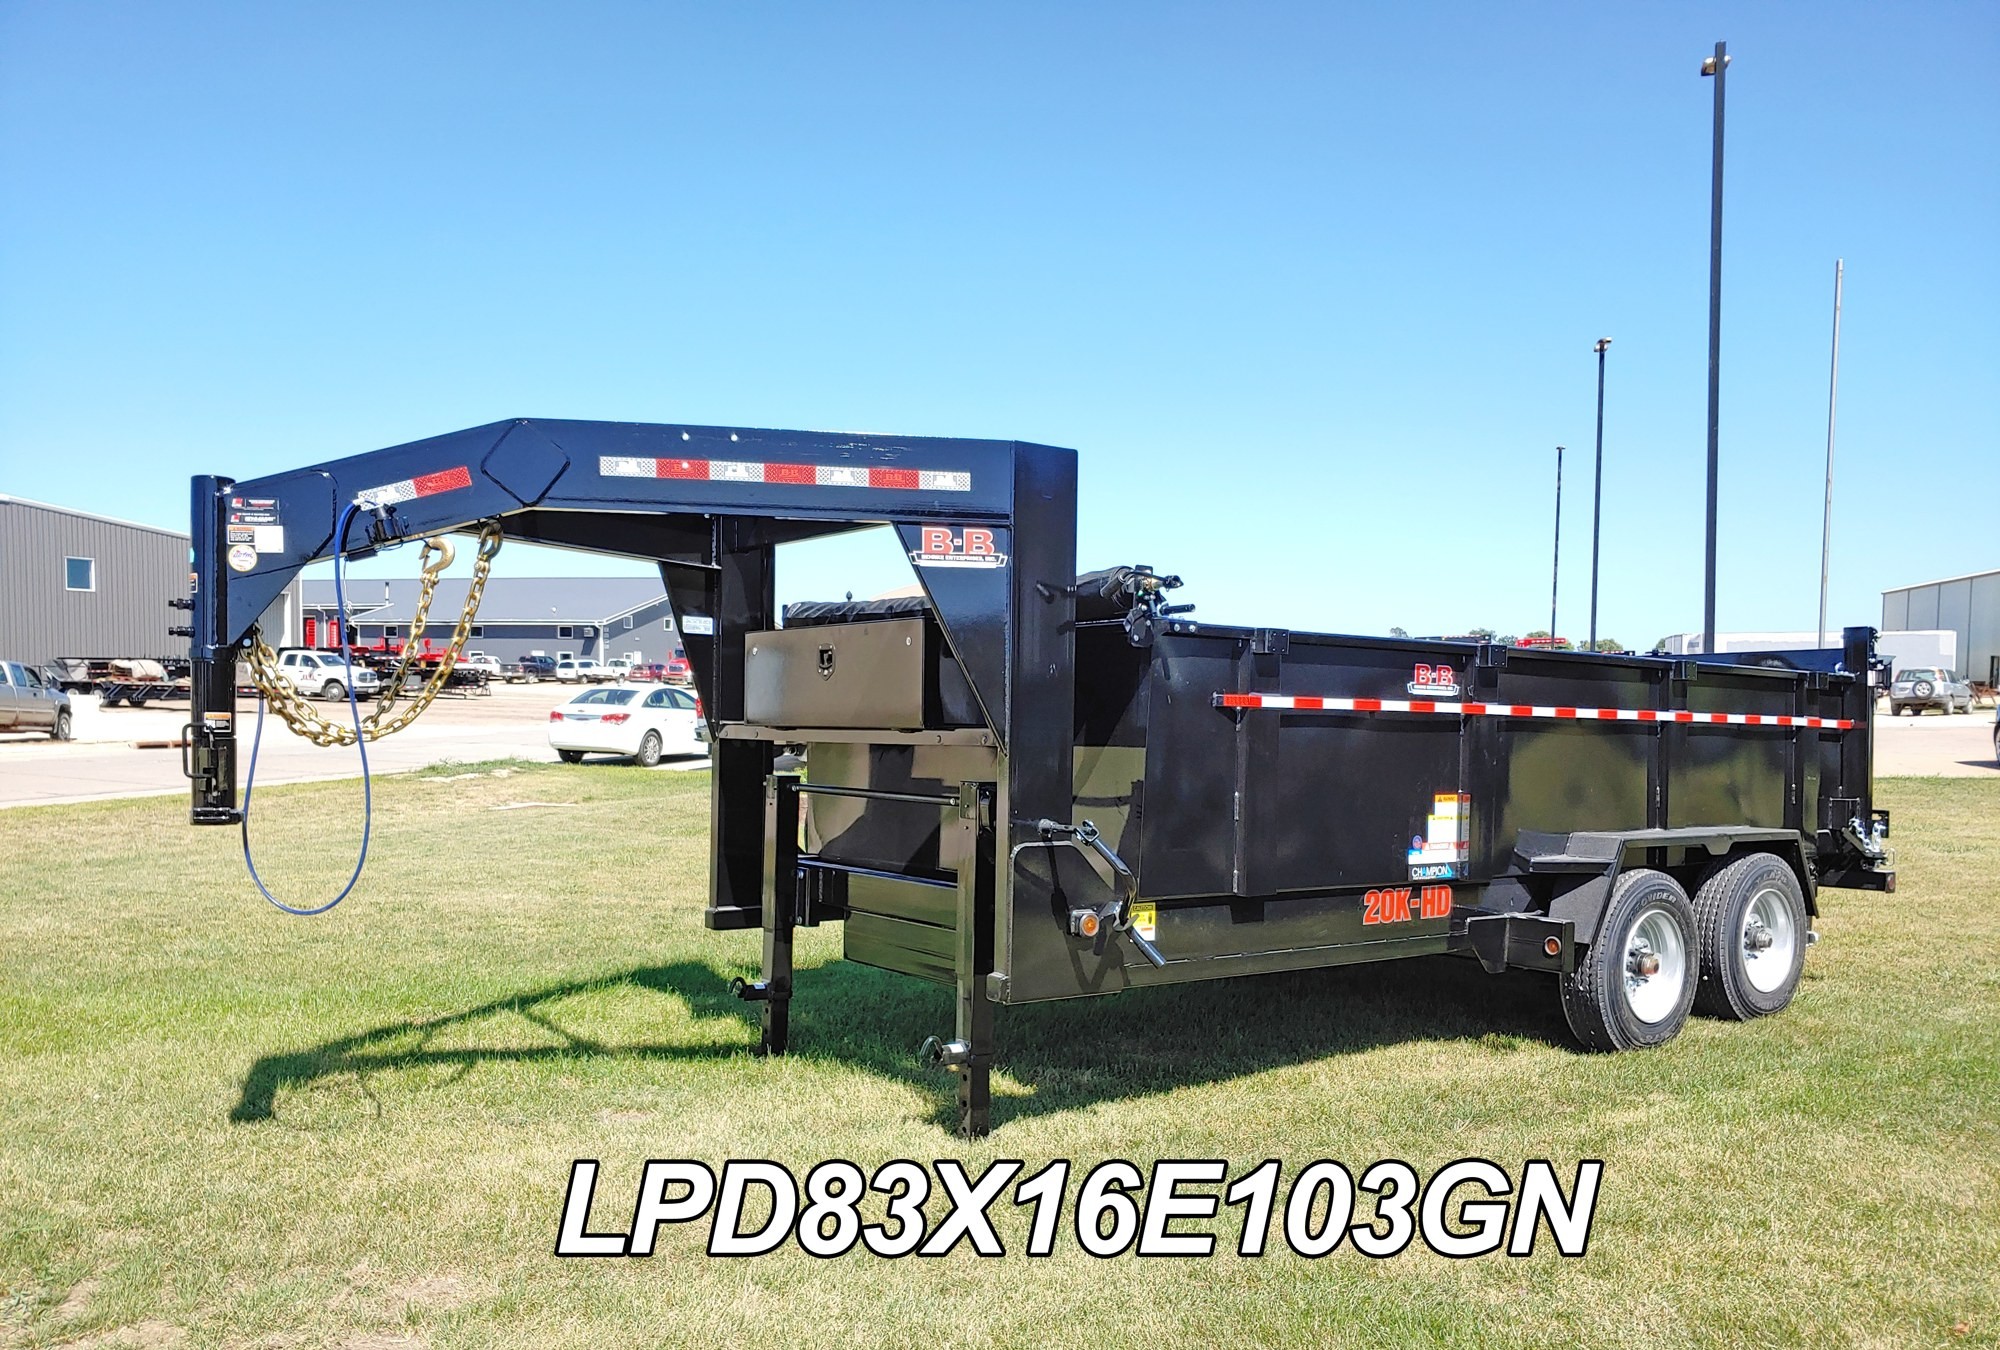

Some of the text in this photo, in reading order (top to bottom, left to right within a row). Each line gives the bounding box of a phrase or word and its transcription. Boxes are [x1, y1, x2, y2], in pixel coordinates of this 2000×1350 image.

[921, 527, 995, 554] B-B
[1414, 663, 1454, 686] B-B
[1362, 884, 1452, 926] 20K-HD
